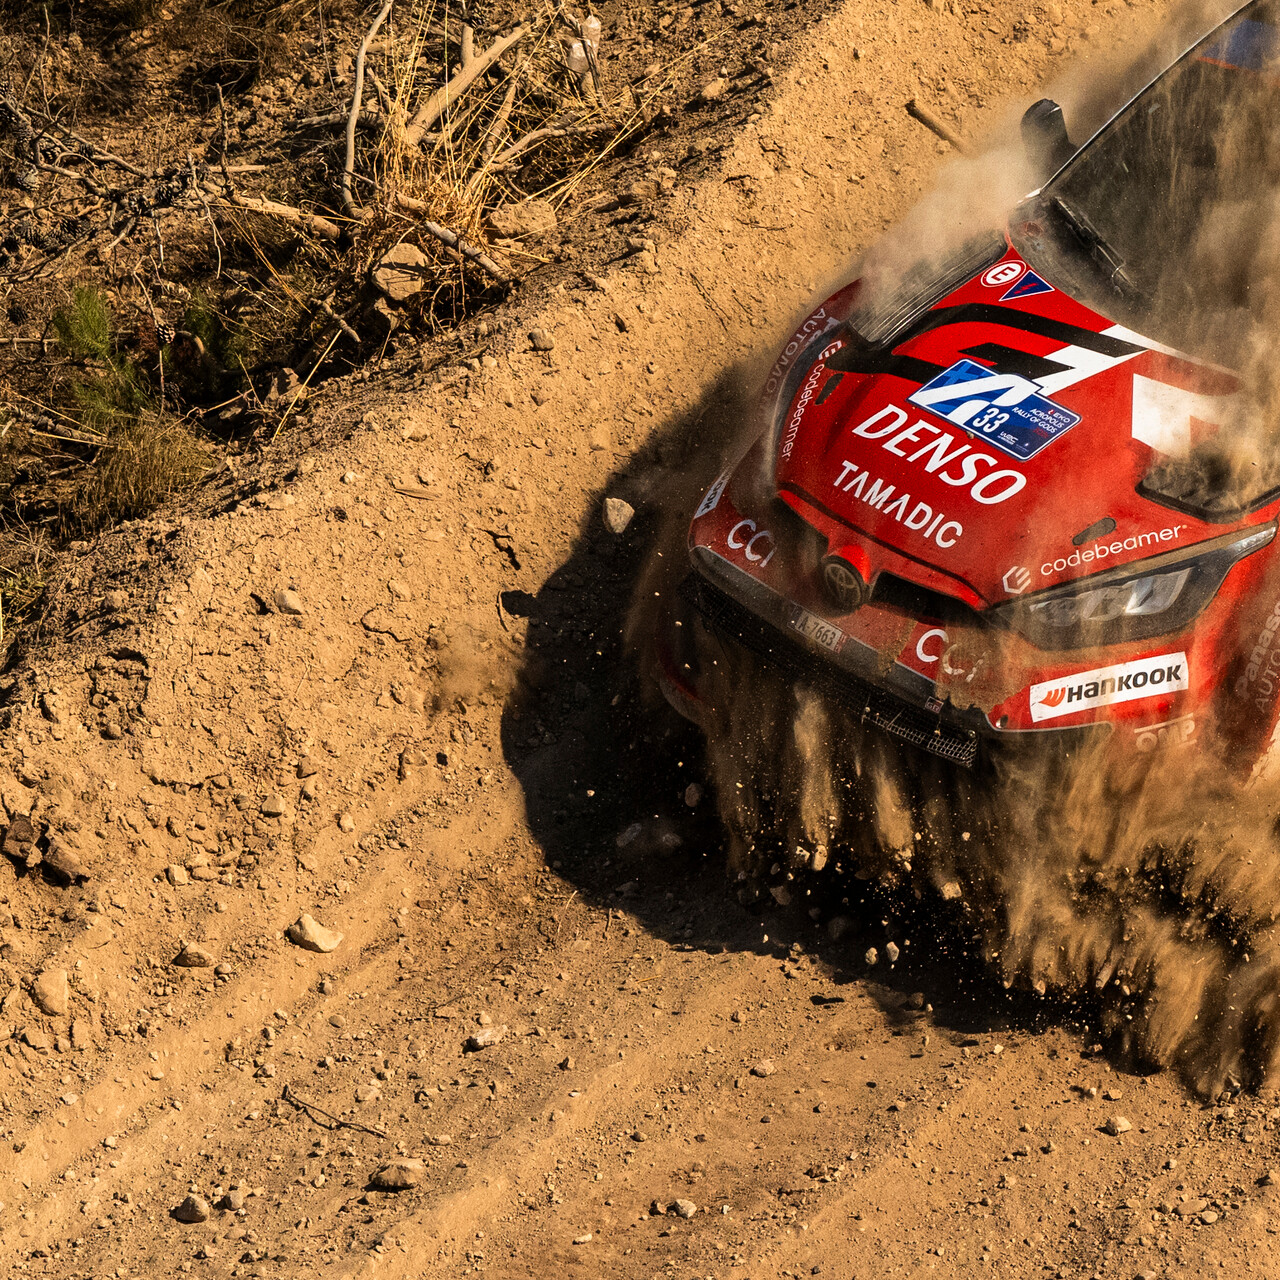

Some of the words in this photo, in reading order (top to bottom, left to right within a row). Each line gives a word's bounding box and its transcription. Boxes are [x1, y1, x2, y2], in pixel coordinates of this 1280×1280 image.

[781, 363, 825, 458] codebeamer
[972, 407, 1010, 433] 33
[1012, 407, 1033, 419] RALLY
[1038, 421, 1057, 433] GODS
[1030, 408, 1065, 428] ACROPOLIS
[852, 404, 1027, 505] DENSO
[833, 459, 963, 549] TAMADIC
[1040, 524, 1182, 576] codebeamer
